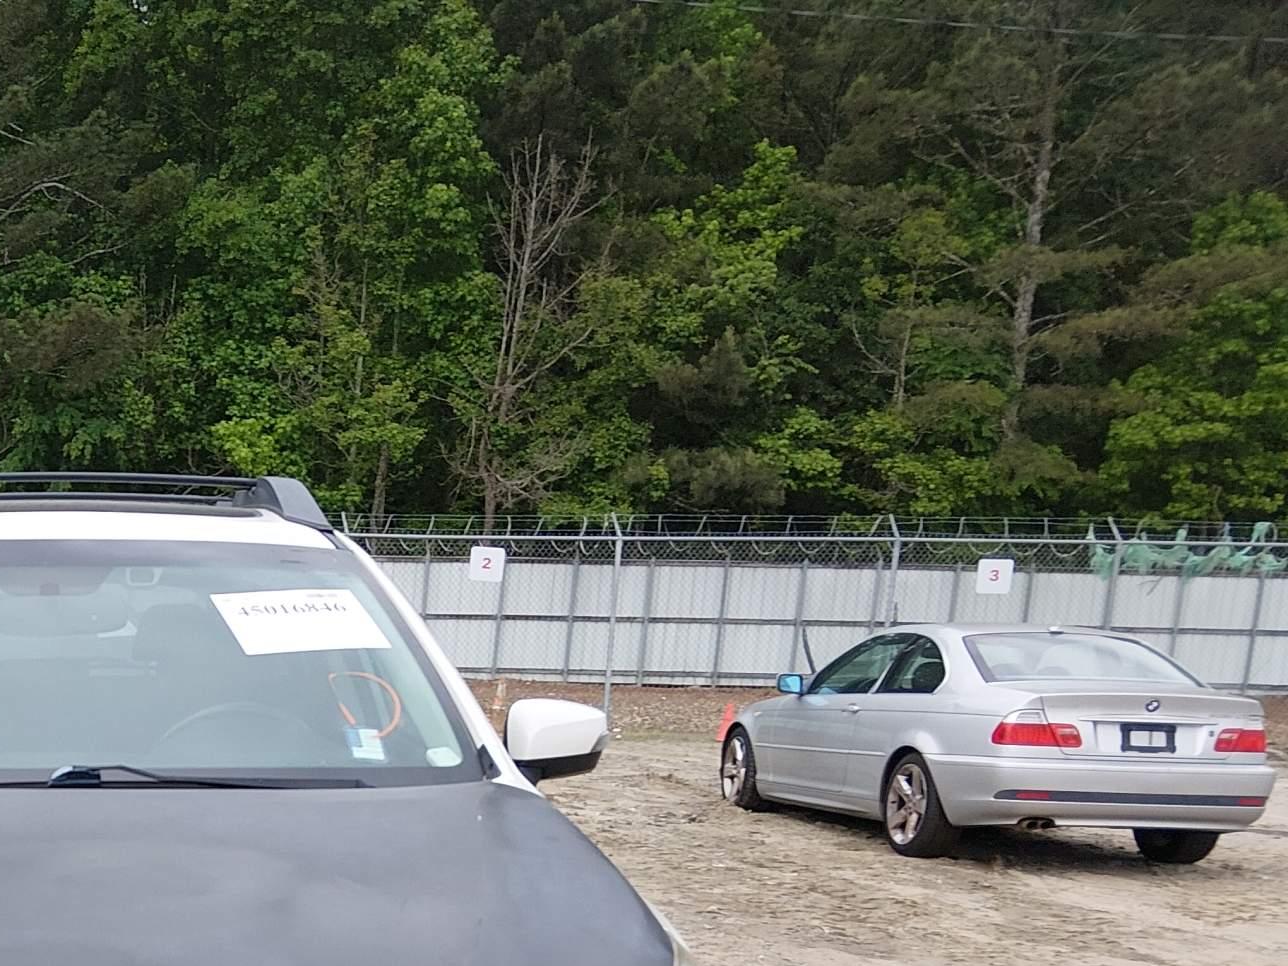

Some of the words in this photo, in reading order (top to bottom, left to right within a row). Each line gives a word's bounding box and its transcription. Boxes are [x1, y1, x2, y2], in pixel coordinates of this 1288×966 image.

[481, 557, 492, 569] 2
[988, 569, 1000, 582] 3
[238, 602, 347, 617] 45016846
